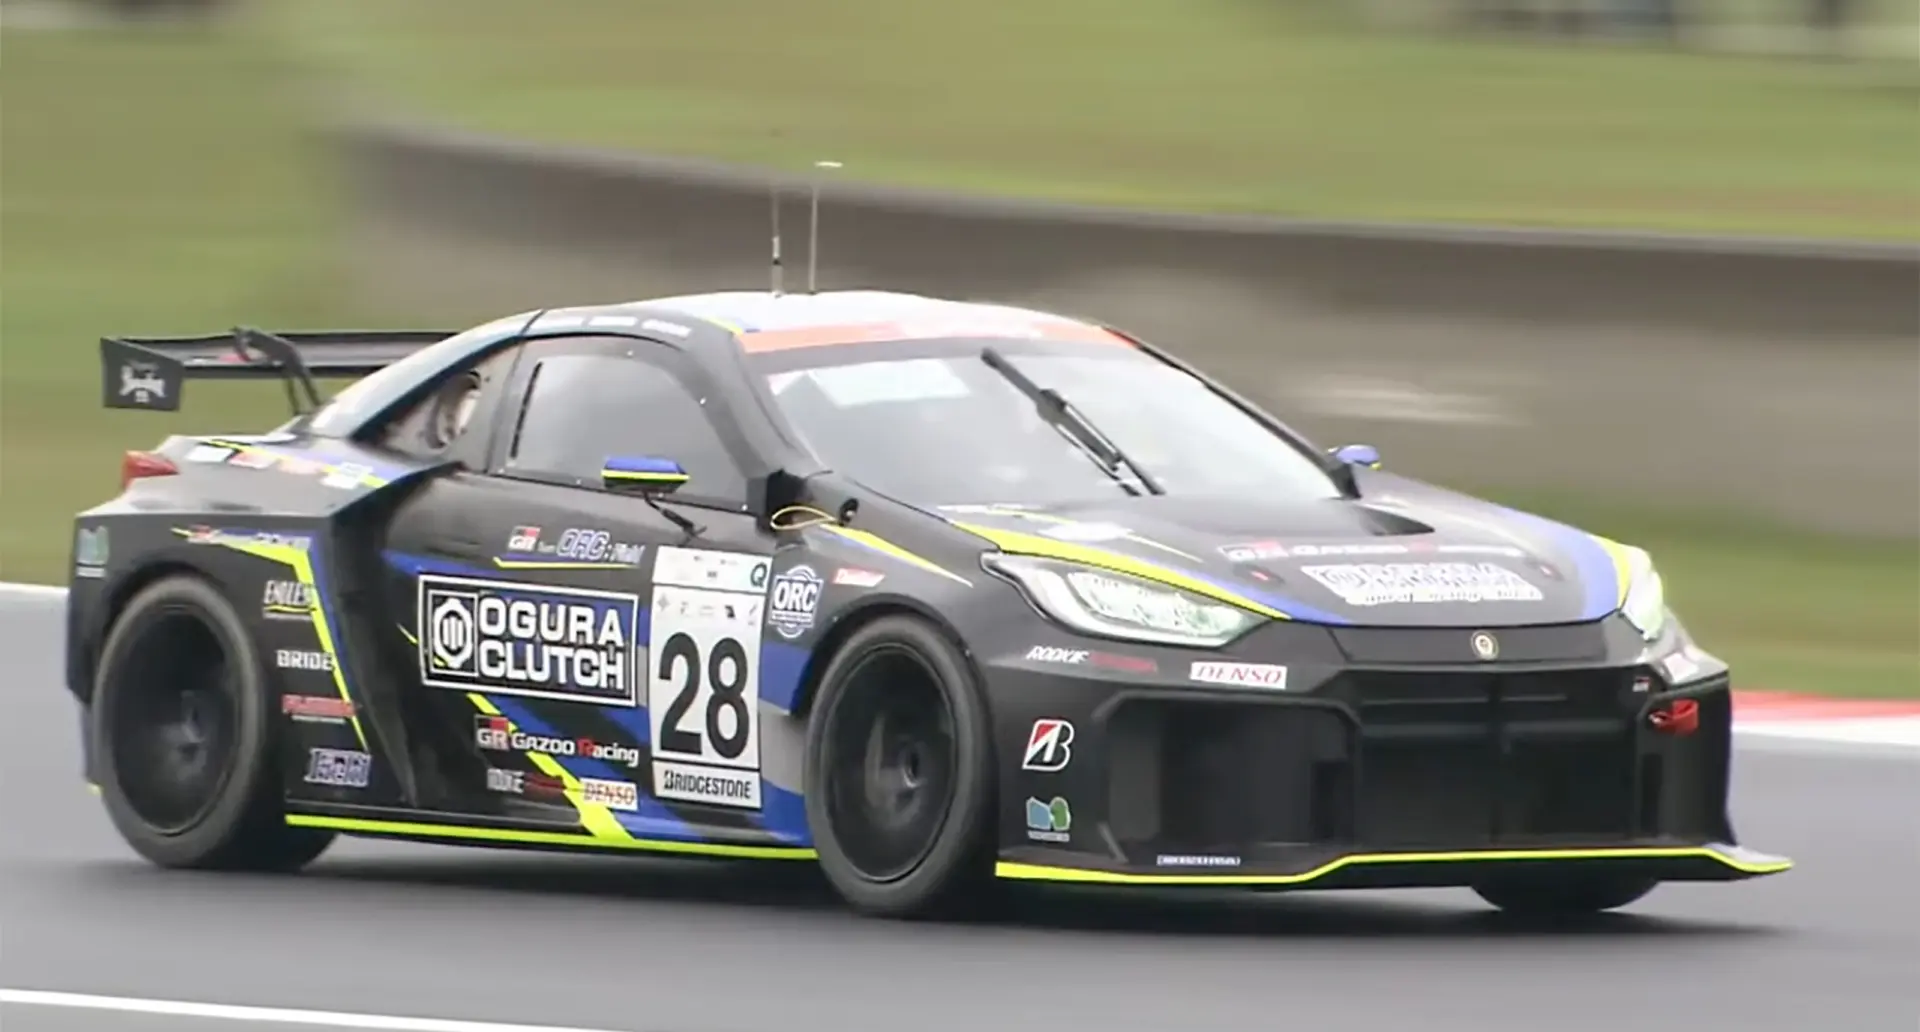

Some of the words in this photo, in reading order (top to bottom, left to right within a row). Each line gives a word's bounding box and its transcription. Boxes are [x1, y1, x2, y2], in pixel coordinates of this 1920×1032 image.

[750, 562, 767, 588] Q
[774, 581, 818, 611] ORC
[479, 597, 624, 647] OGURA
[276, 649, 333, 671] BRIDE
[479, 640, 624, 690] CLUTCH
[659, 632, 748, 759] 28
[477, 728, 508, 750] GR
[511, 733, 575, 755] GAZOO
[576, 737, 639, 767] Racing
[664, 770, 751, 798] BRIDGESTONE
